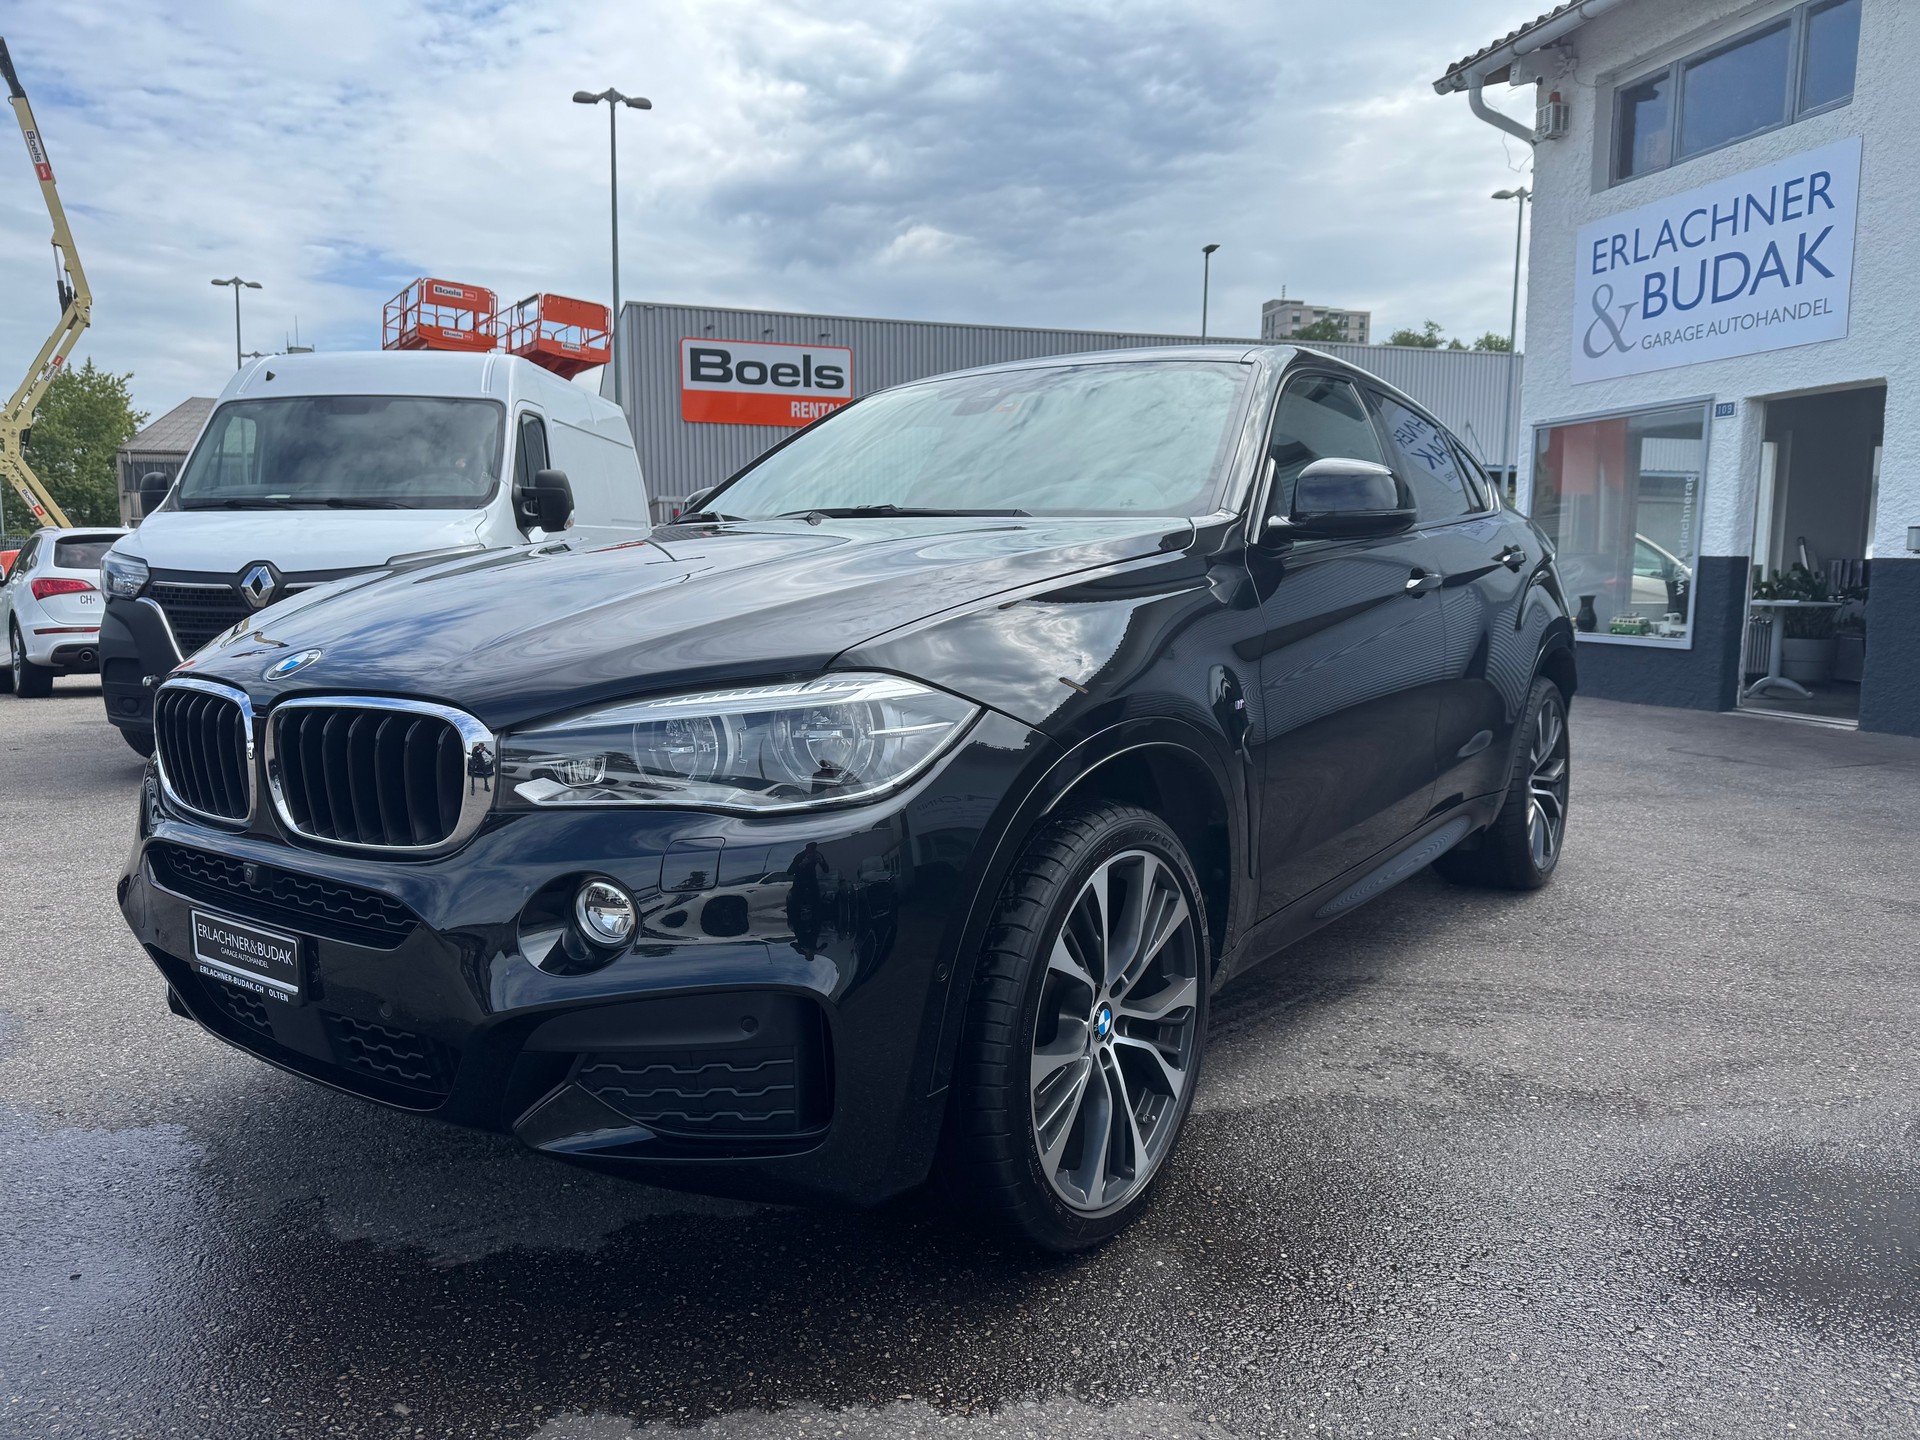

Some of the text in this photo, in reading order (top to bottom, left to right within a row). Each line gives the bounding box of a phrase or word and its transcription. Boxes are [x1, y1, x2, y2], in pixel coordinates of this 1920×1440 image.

[25, 131, 42, 162] Boels
[1592, 171, 1835, 275] ERLACHNER
[1582, 225, 1835, 358] & BUDAK
[1641, 298, 1833, 350] GARAGE AUTOHANDEL
[690, 347, 844, 390] Boels
[790, 401, 841, 418] RENTA
[197, 923, 293, 966] ERLACHNER&BUDAK
[200, 965, 289, 1002] ERLACHNER-BUDAK.CH OLTEN
